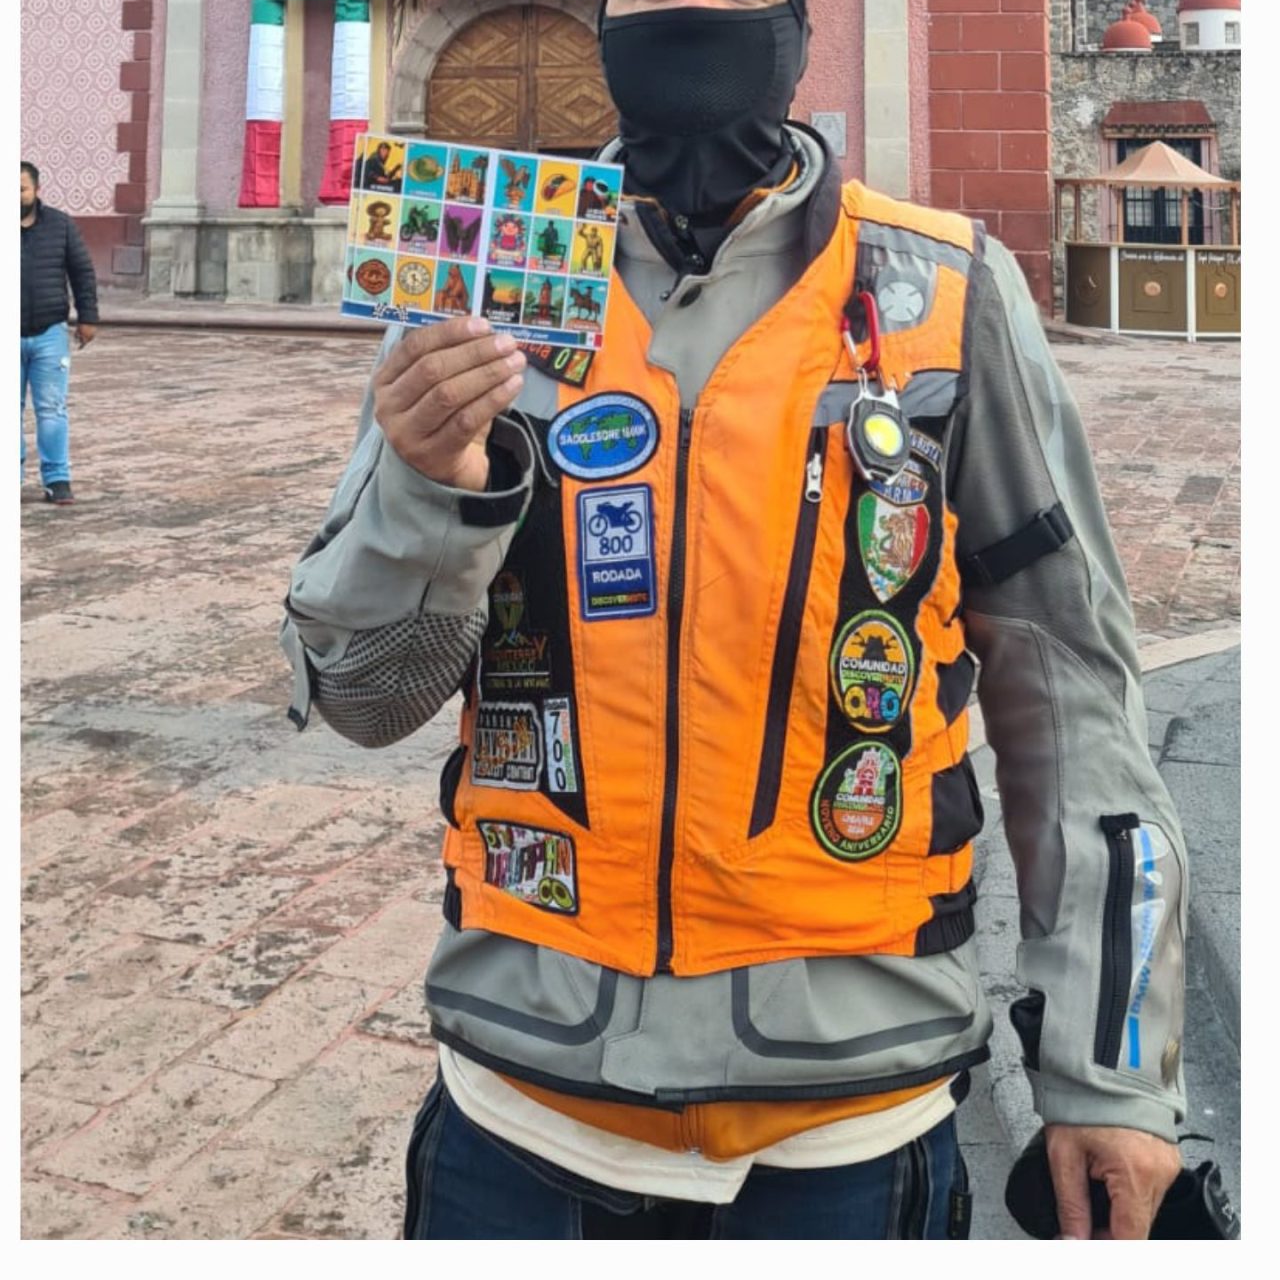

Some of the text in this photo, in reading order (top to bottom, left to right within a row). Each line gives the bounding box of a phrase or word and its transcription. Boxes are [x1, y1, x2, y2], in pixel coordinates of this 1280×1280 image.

[600, 535, 633, 556] 800
[592, 568, 642, 584] RODADA
[841, 658, 906, 675] COMUNIDAD
[840, 805, 894, 852] ANIVERSARIO
[1130, 965, 1151, 1015] BMW
